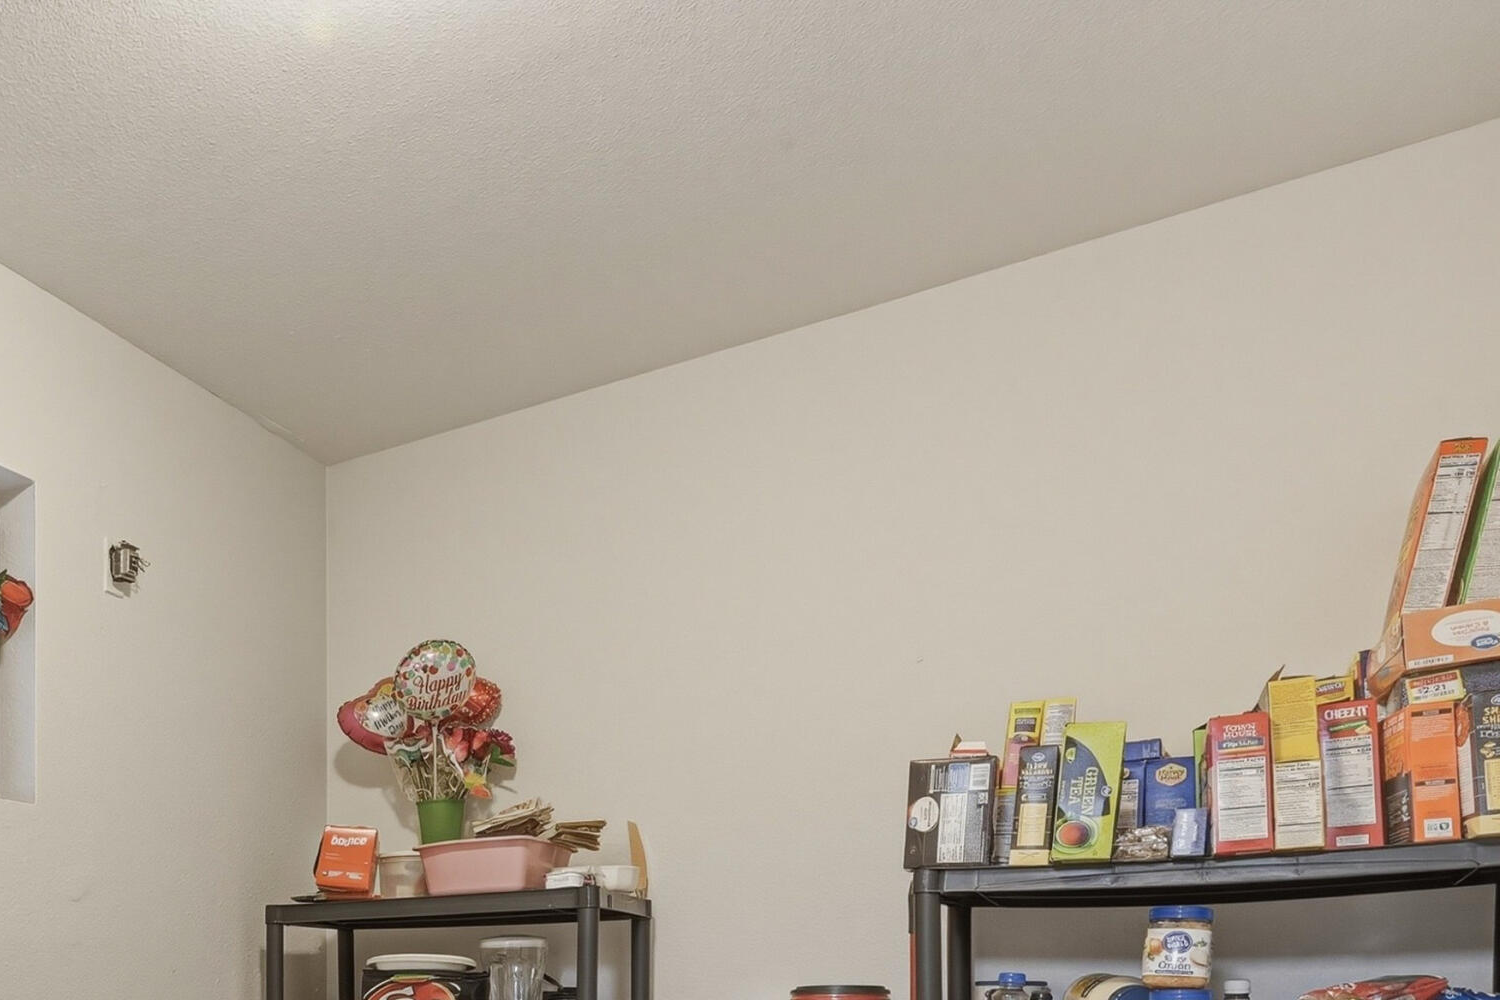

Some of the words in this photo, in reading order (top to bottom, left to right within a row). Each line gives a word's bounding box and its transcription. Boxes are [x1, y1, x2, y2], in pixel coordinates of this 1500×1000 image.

[413, 672, 463, 694] Happy
[406, 687, 467, 710] Birthday
[1222, 723, 1256, 732] TOWN
[1223, 730, 1258, 739] HOUSE
[1068, 777, 1084, 806] TEA
[1081, 767, 1099, 815] GREEN
[1158, 960, 1191, 971] Onion
